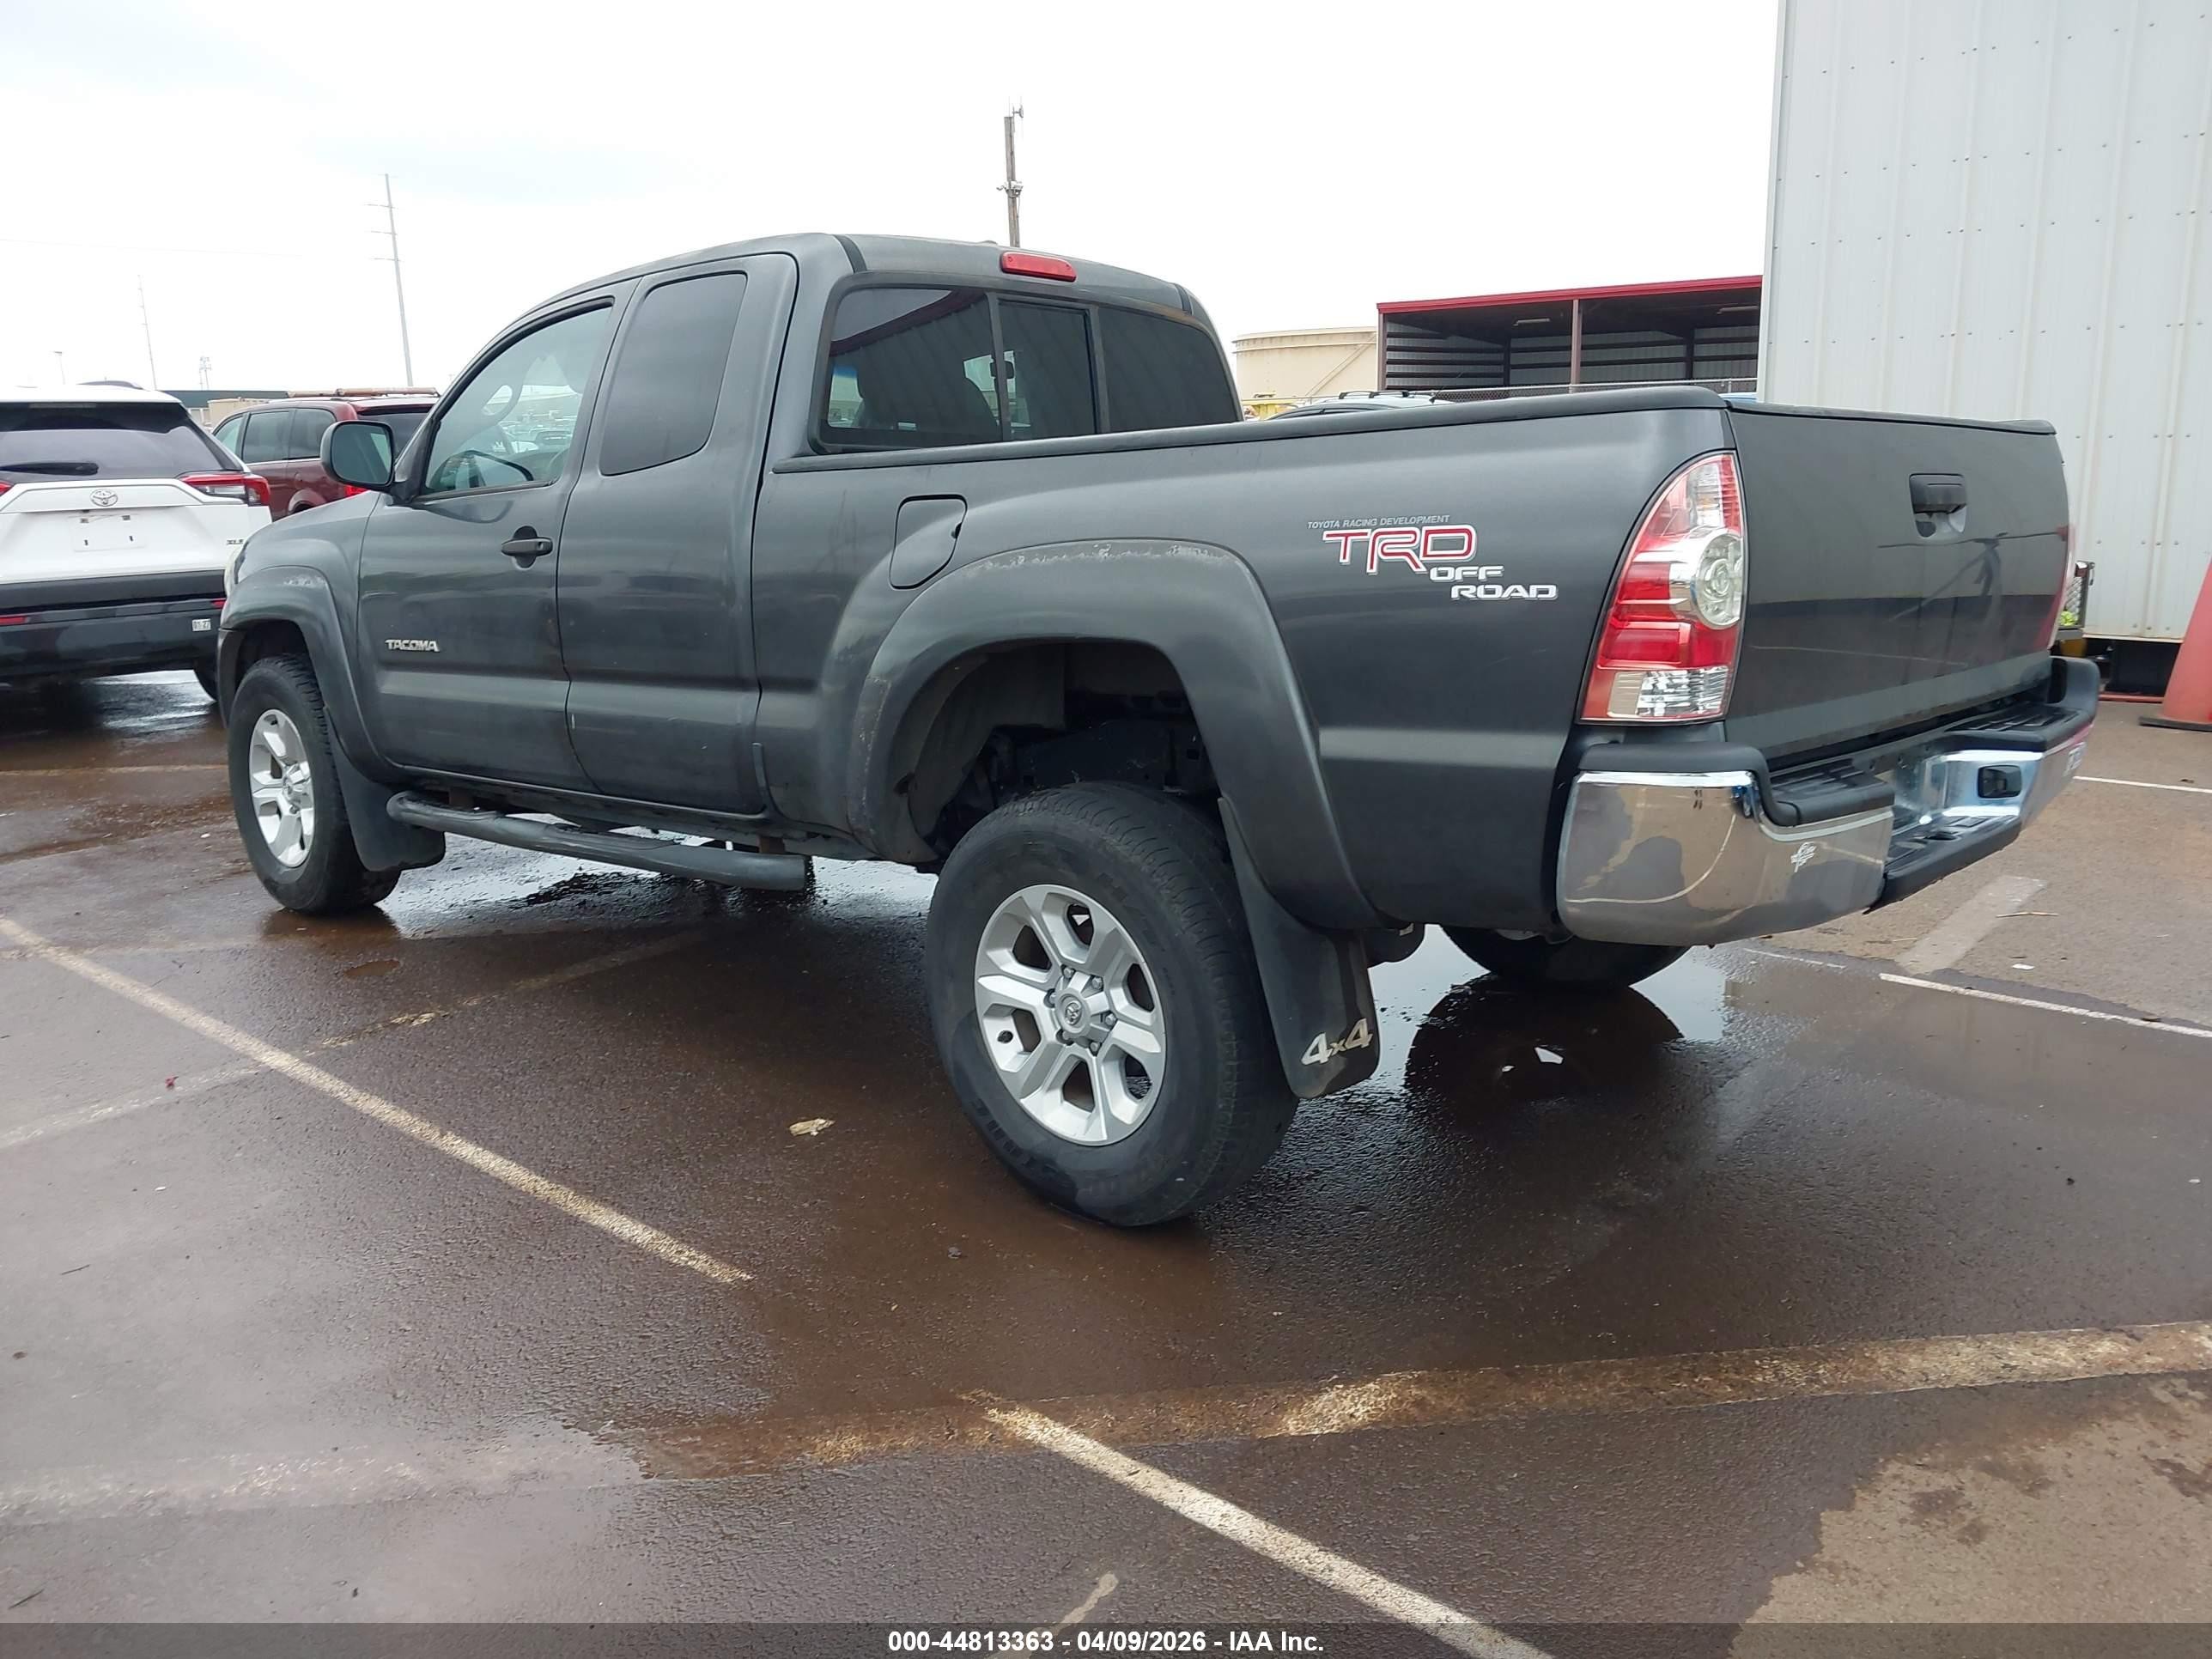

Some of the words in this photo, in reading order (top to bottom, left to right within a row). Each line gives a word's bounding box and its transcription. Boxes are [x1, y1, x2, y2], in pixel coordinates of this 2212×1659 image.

[1307, 520, 1340, 530] TOYOTA
[1342, 518, 1377, 528] RACING
[1379, 515, 1450, 526] DEVELOPMENT
[1322, 525, 1477, 575] TRD
[1430, 565, 1504, 582] OFF
[1450, 584, 1559, 600] ROAD
[384, 638, 441, 653] TACOMA
